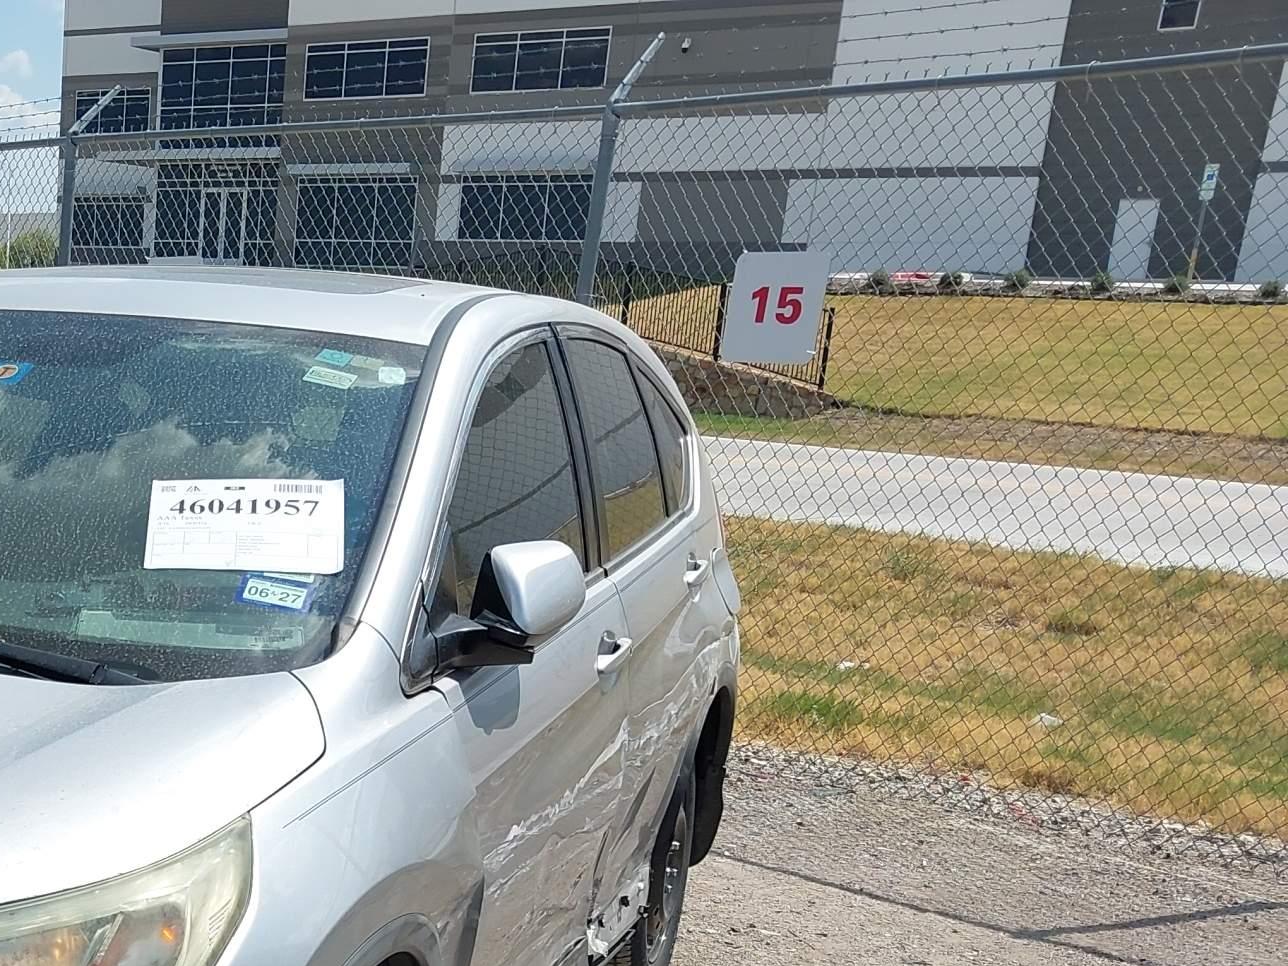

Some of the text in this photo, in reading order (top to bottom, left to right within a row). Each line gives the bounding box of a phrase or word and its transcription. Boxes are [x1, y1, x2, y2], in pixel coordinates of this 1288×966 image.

[752, 286, 804, 325] 15
[170, 498, 320, 517] 46041957
[248, 585, 270, 598] 06
[278, 591, 302, 604] 27
